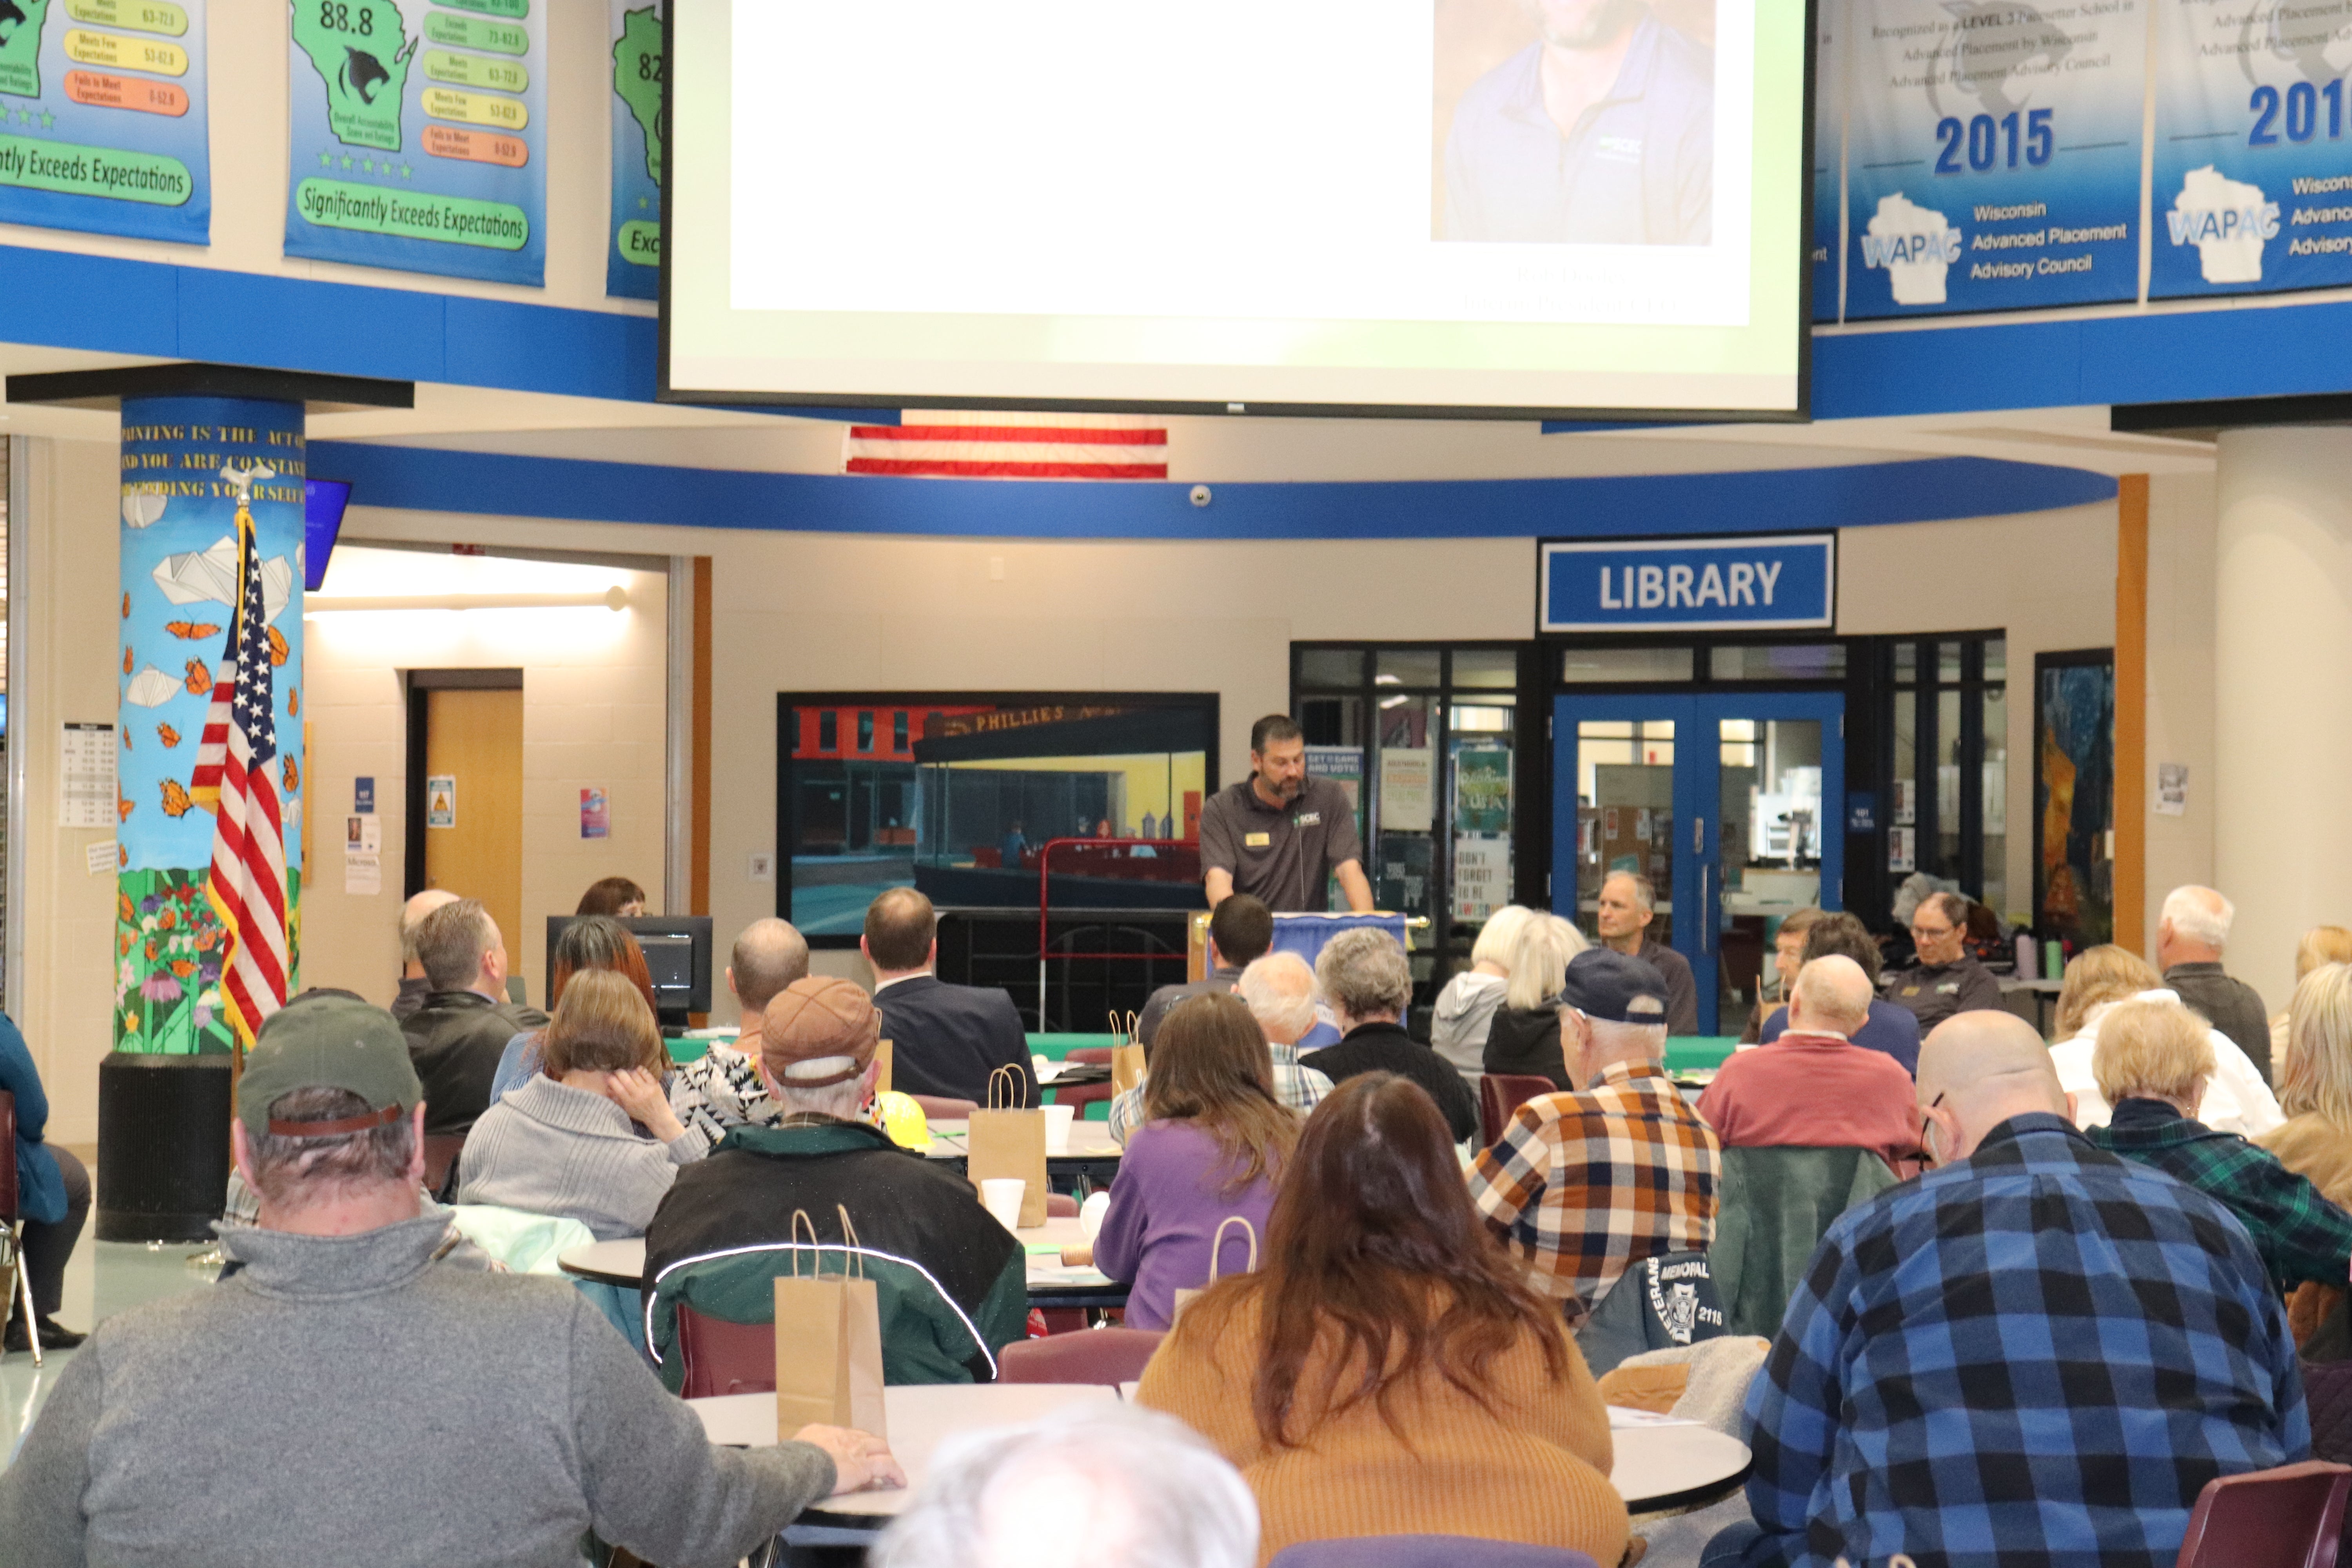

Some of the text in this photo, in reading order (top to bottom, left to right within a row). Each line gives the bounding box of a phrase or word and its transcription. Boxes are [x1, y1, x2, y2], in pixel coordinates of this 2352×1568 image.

[320, 1, 373, 36] 88.8
[1962, 13, 2003, 29] LEVEL
[1935, 109, 2054, 176] 2015
[29, 150, 87, 181] Exceeds
[93, 158, 183, 194] Expectations
[304, 187, 523, 240] Significantly Exceeds Expectations
[1973, 201, 2047, 222] Wisconsin
[1971, 222, 2127, 251] Advanced Placement
[1970, 253, 2093, 280] Advisory Council
[192, 424, 211, 441] IS
[218, 425, 257, 443] THE
[142, 453, 174, 469] YOU
[180, 453, 221, 470] ARE
[1600, 561, 1782, 609] LIBRARY
[976, 706, 1064, 732] PHILLIES
